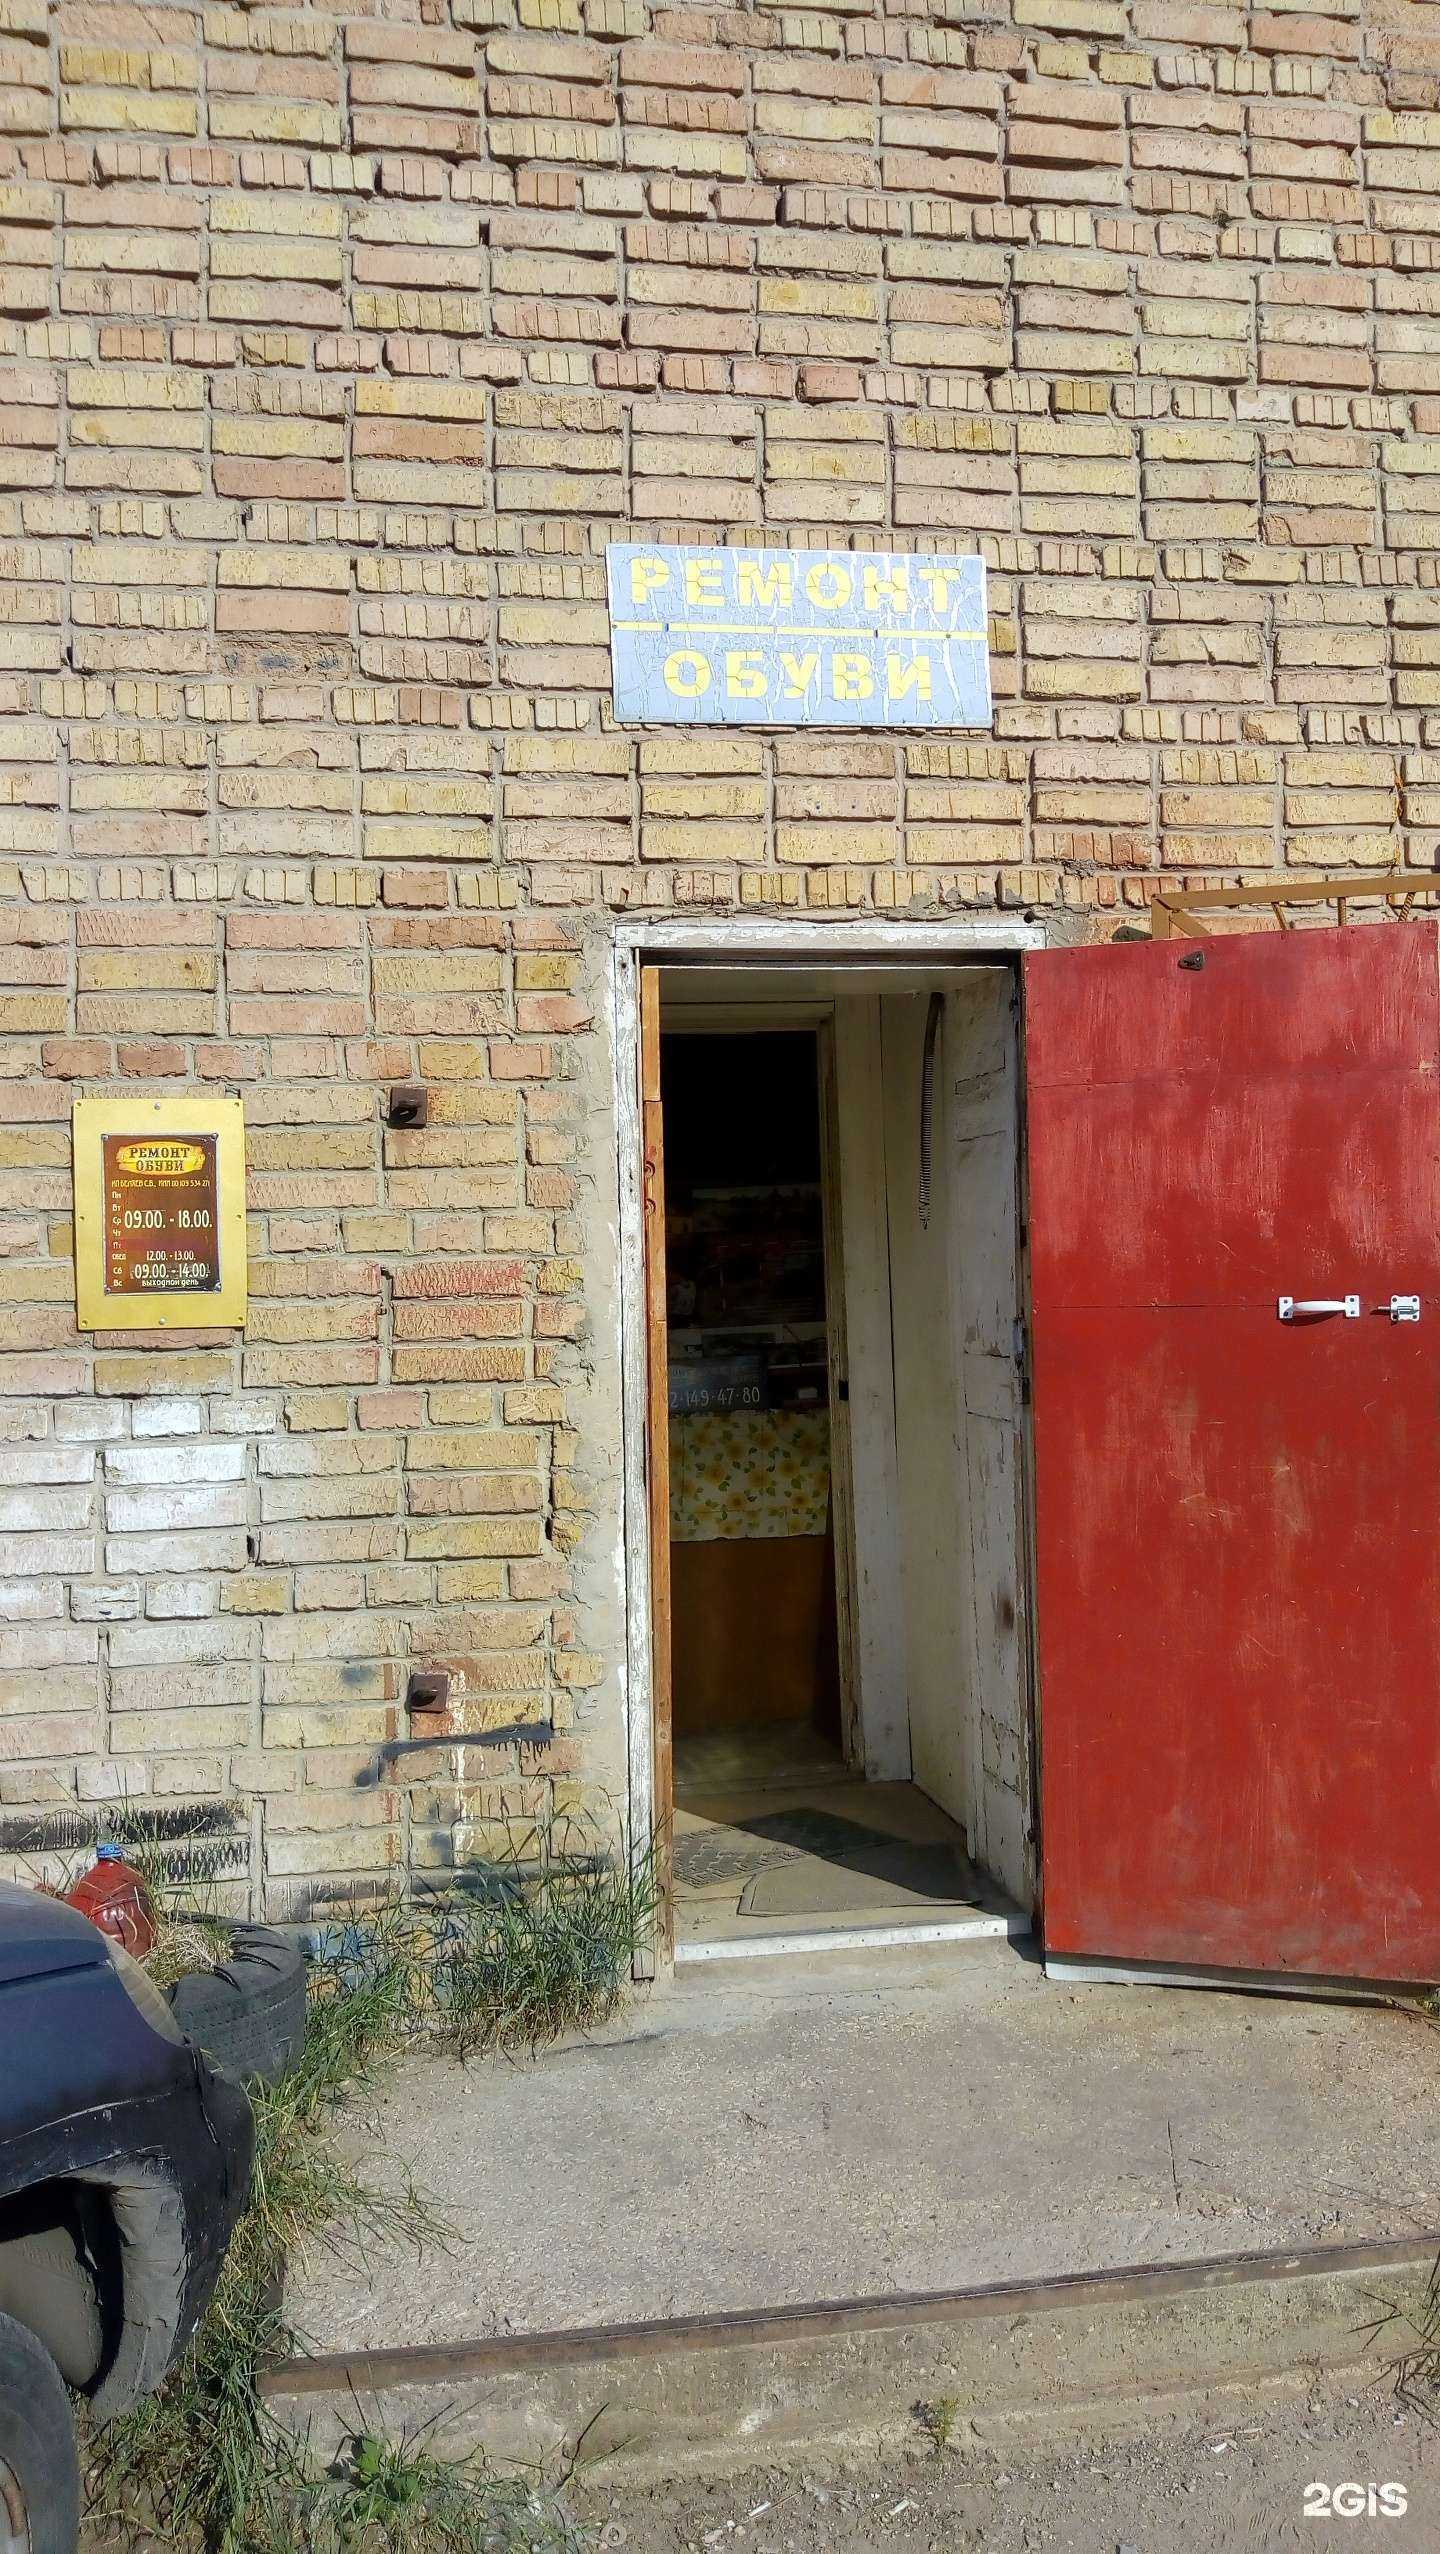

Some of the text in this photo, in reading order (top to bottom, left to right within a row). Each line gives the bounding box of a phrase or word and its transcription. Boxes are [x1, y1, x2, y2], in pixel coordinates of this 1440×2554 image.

[630, 557, 961, 614] РЕМОНТ
[663, 649, 933, 701] ОБУВИ
[129, 1147, 190, 1159] РЕМОНТ
[136, 1159, 184, 1172] ОБУВИ
[112, 1216, 121, 1226] Ср
[112, 1229, 121, 1237] Чт
[113, 1279, 122, 1287] Вс
